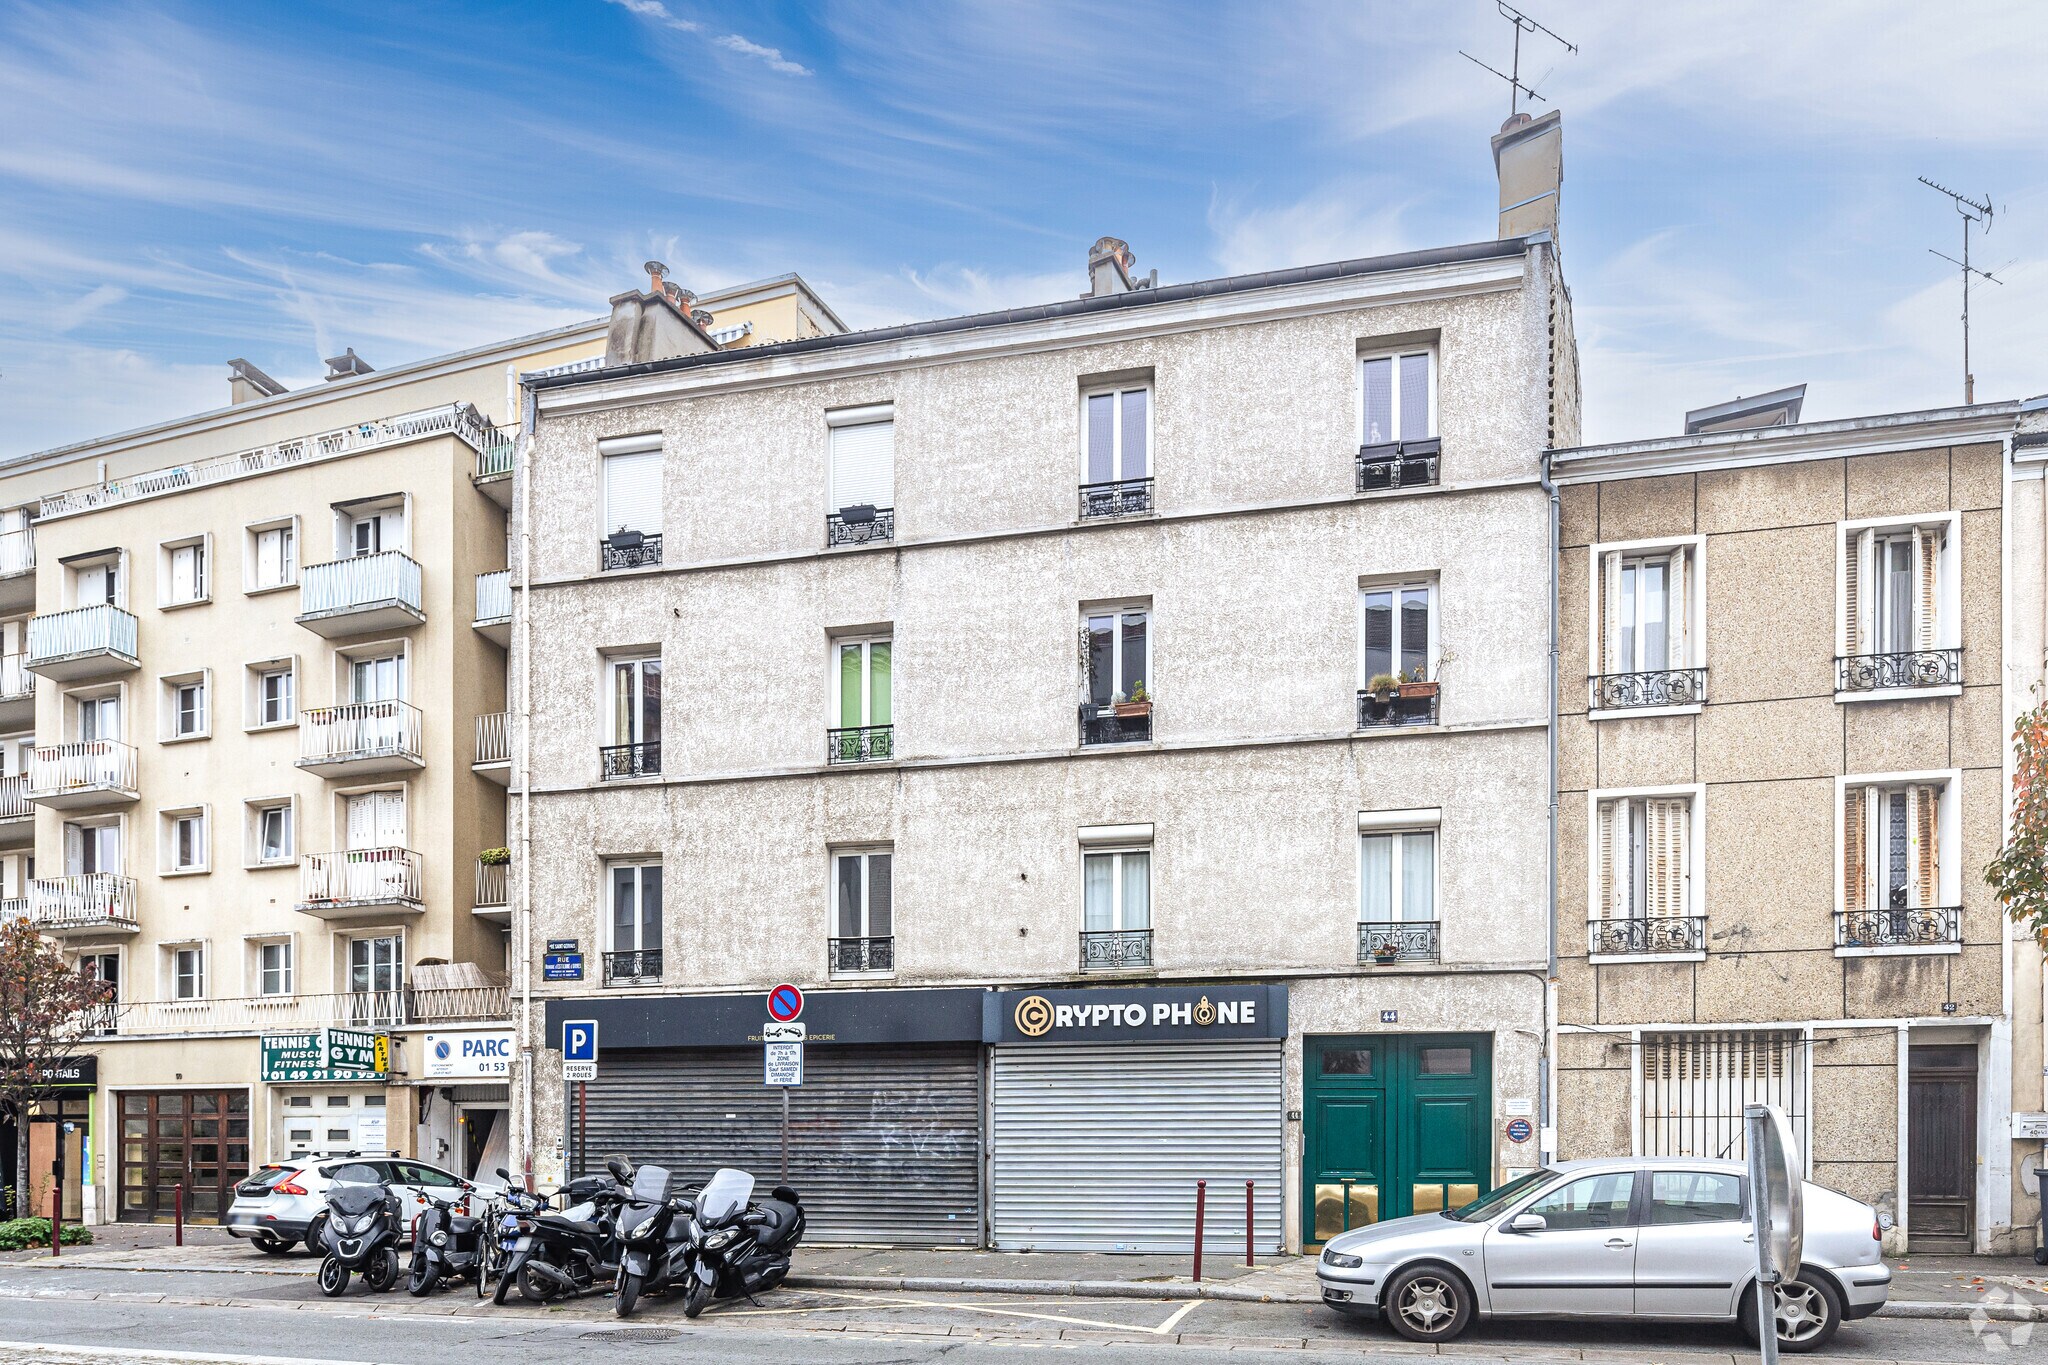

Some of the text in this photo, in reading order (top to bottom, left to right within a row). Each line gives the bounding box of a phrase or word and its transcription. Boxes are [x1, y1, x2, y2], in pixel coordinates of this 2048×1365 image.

[1152, 995, 1256, 1027] PHONE
[1943, 1003, 1955, 1011] 42
[1382, 1011, 1396, 1021] 44
[264, 1036, 311, 1049] TENNIS
[330, 1031, 375, 1049] TENNIS
[572, 1029, 587, 1055] P
[330, 1047, 375, 1063] GYM
[274, 1061, 322, 1069] FITNESS
[478, 1062, 506, 1072] 01 53
[270, 1071, 286, 1080] 01
[290, 1071, 309, 1080] 49
[312, 1071, 329, 1079] 91
[333, 1070, 353, 1079] 90
